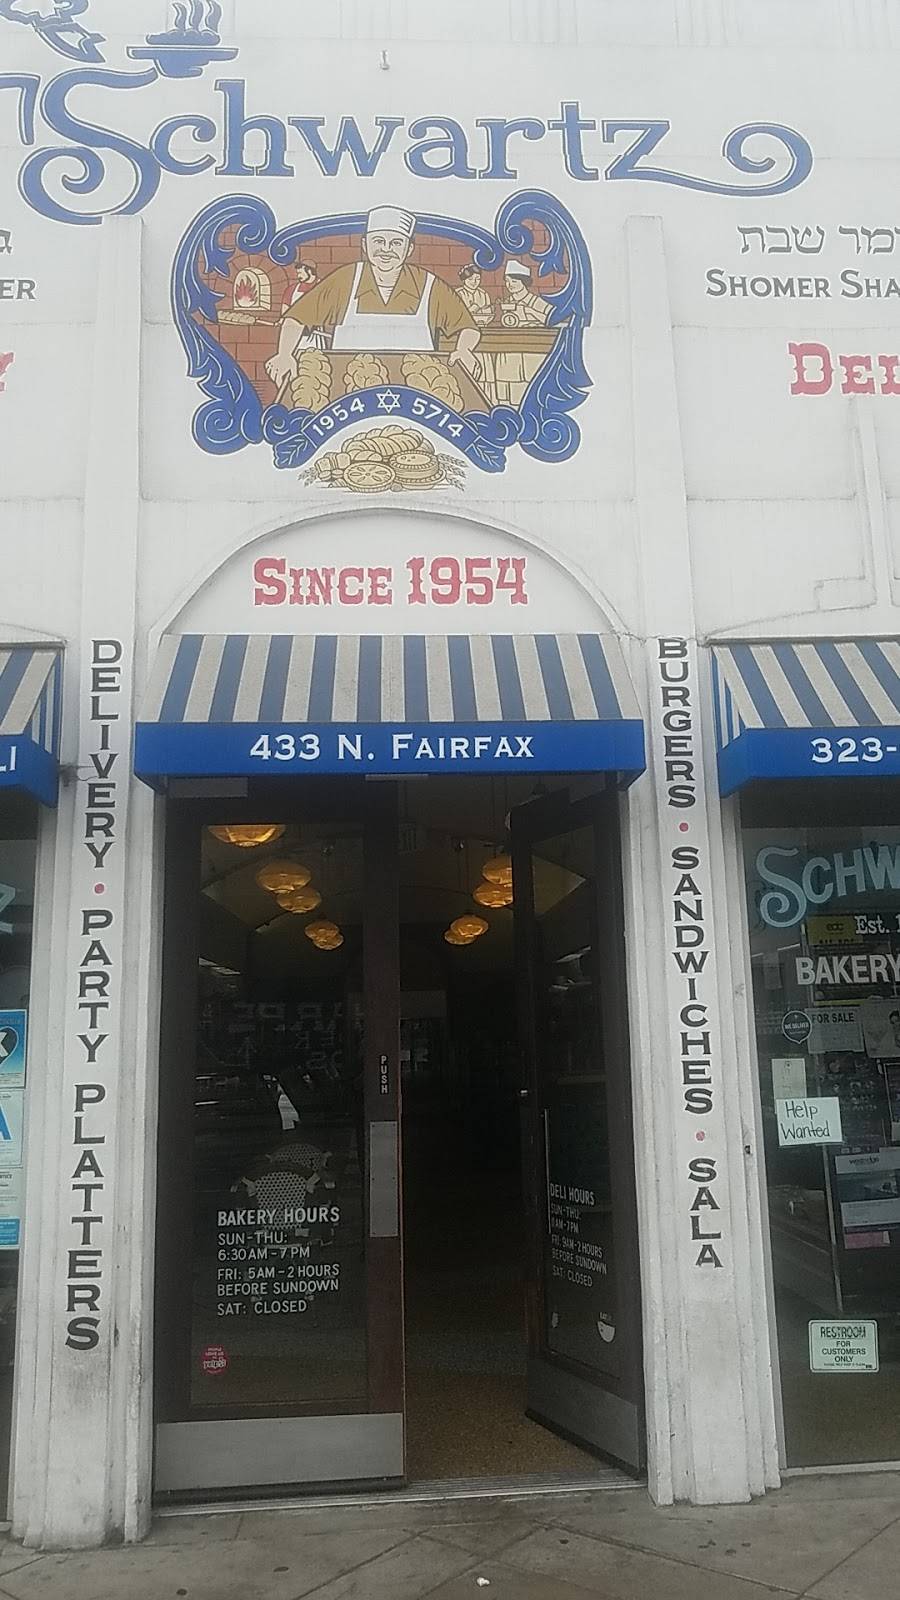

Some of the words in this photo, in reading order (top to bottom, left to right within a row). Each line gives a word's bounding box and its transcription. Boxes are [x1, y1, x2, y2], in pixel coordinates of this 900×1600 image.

[17, 67, 814, 225] Schwartz
[737, 225, 825, 254] שבת
[312, 398, 365, 437] 1954
[411, 398, 465, 438] 5714
[406, 557, 528, 605] 1954
[658, 637, 696, 808] BURGERS
[84, 639, 122, 868] DELIVERY
[249, 733, 320, 760] 433
[338, 734, 374, 760] N.
[855, 915, 890, 934] Est.
[670, 845, 714, 1115] SANDWICHES
[795, 953, 900, 985] BAKERY
[77, 909, 113, 1063] PARTY
[812, 1013, 830, 1024] FOR
[832, 1013, 854, 1023] SALE
[380, 1055, 389, 1094] PUSH
[785, 1100, 818, 1120] Help
[780, 1120, 831, 1140] Wanted
[550, 1183, 566, 1200] DELI
[569, 1187, 595, 1206] HOURS
[64, 1083, 106, 1351] PLATTERS
[217, 1209, 276, 1227] BAKERY
[284, 1207, 340, 1224] HOURS
[688, 1158, 724, 1268] SALA
[552, 1248, 574, 1264] BEFORE
[575, 1254, 607, 1275] SUNDOWN
[582, 1242, 602, 1259] HOURS
[217, 1268, 242, 1281] FRI:
[297, 1263, 340, 1277] HOURS
[567, 1270, 593, 1287] CLOSED
[217, 1282, 268, 1296] BEFORE
[273, 1278, 339, 1295] SUNDOWN
[217, 1302, 247, 1316] SAT:
[254, 1300, 307, 1314] CLOSED
[820, 1326, 866, 1338] RESTROOM
